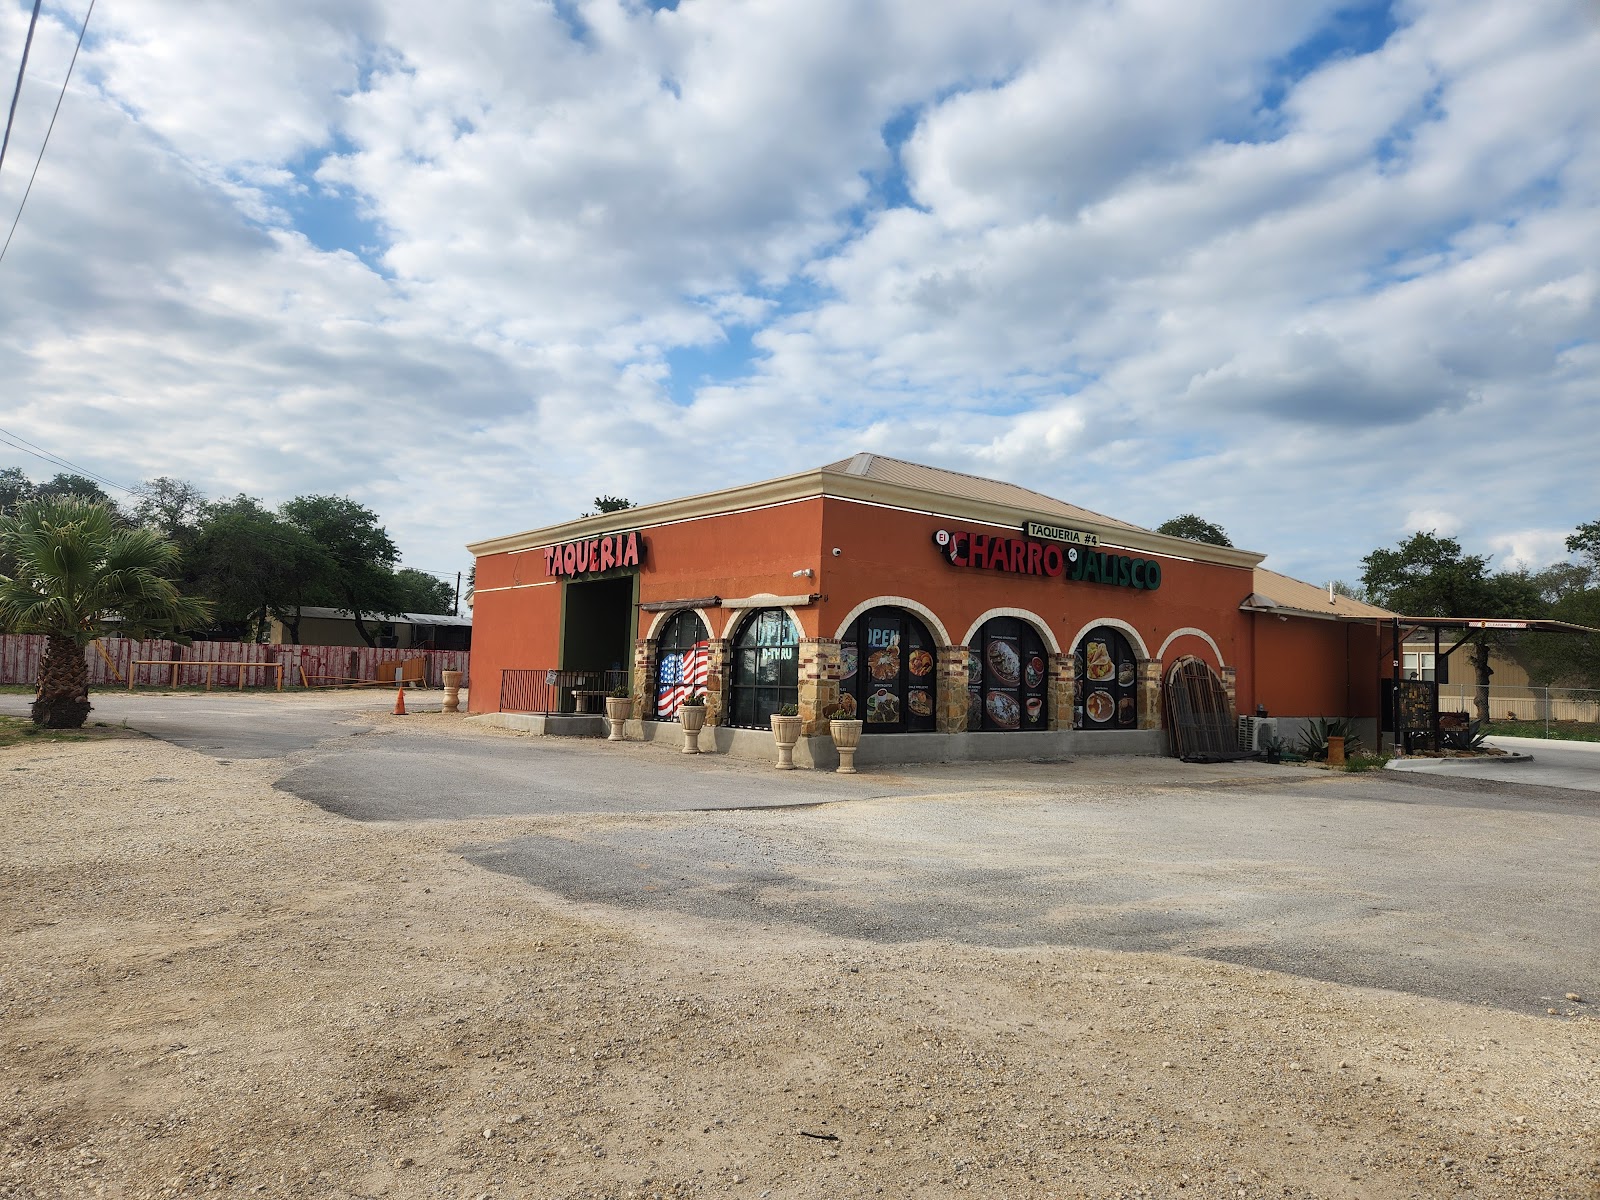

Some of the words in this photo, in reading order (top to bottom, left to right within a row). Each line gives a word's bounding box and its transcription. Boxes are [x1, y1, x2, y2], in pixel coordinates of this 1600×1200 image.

[544, 532, 639, 578] TAQUERIA
[1030, 524, 1080, 542] TAQUERIA
[1084, 534, 1098, 546] #4
[949, 531, 1063, 577] CHARRO
[1070, 548, 1161, 590] JALISCO
